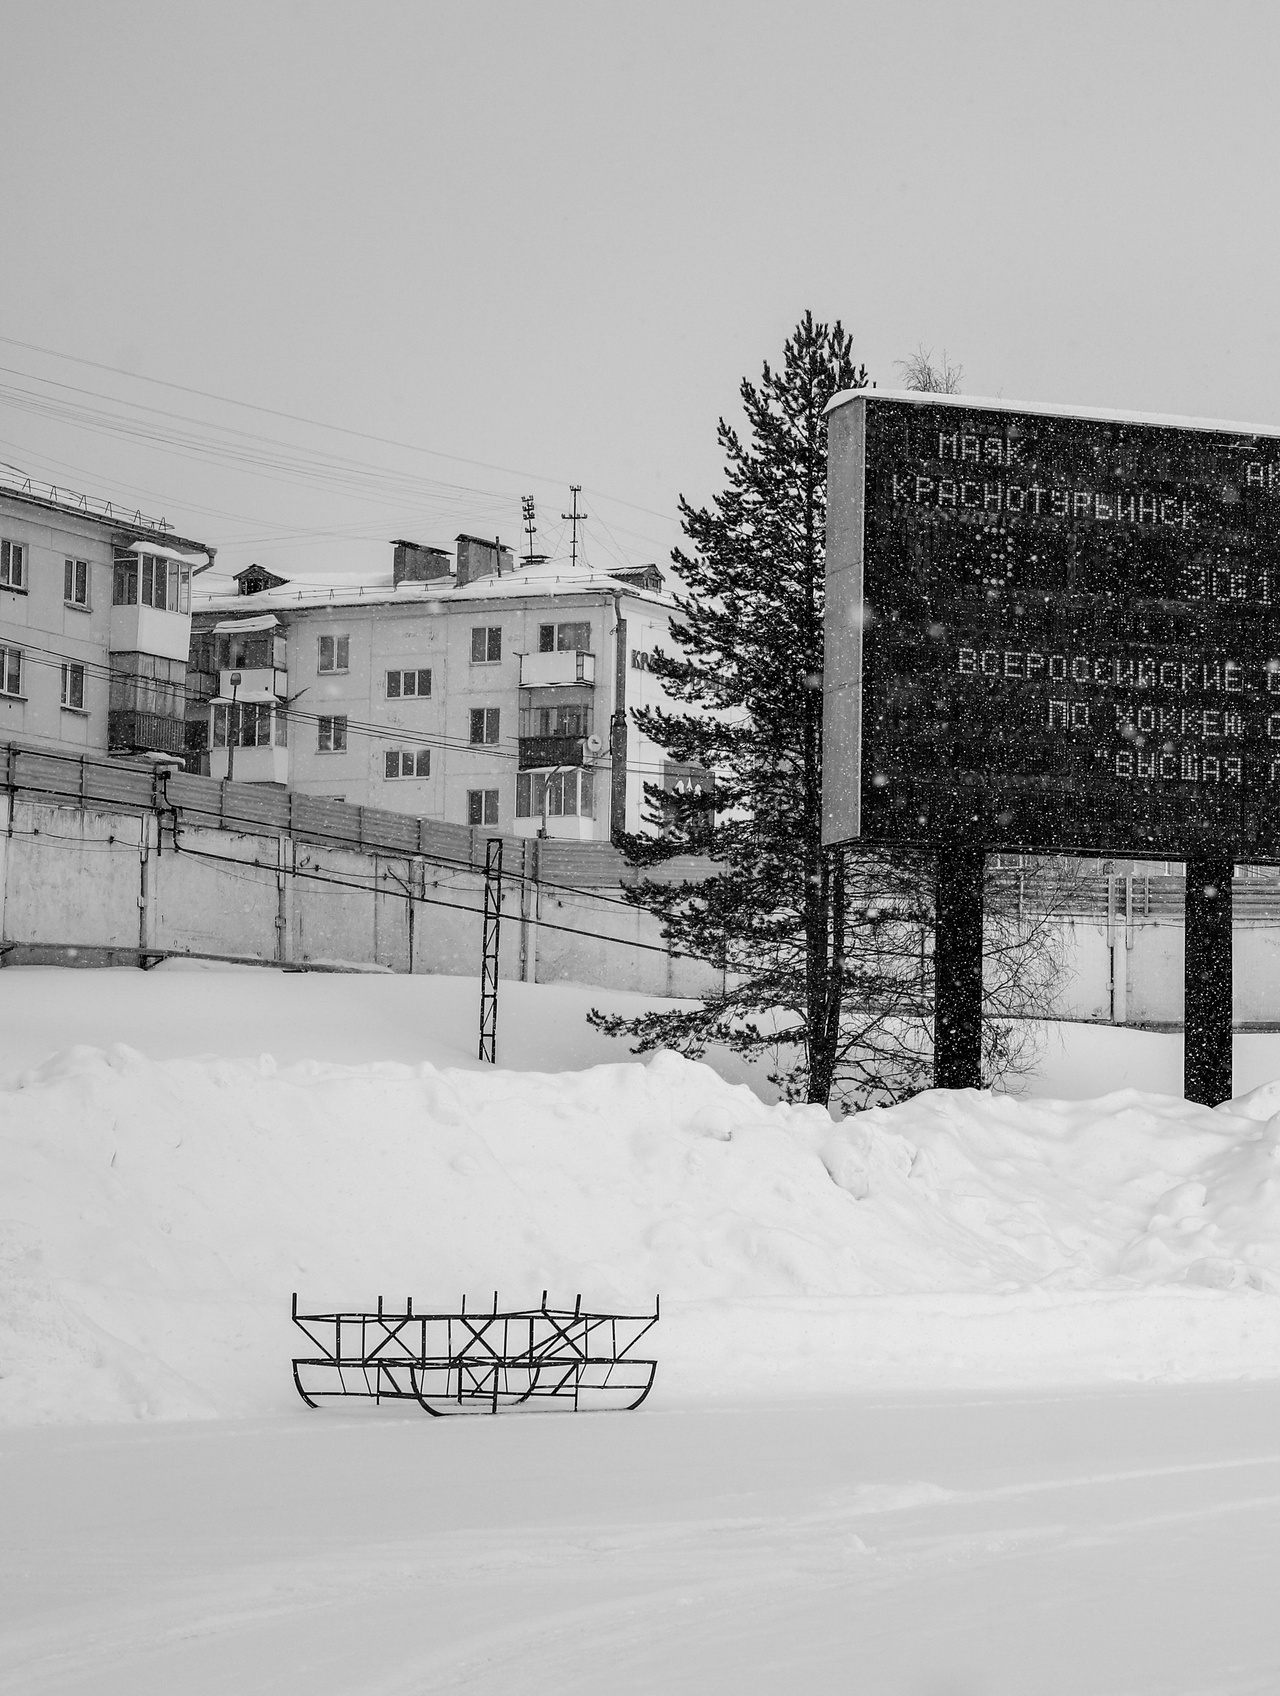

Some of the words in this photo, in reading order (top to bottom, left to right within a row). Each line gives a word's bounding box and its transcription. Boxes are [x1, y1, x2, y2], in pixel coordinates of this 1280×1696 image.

[938, 431, 1027, 467] МАЯК
[892, 474, 1200, 529] КРАСНОТУРЬИНСК
[974, 526, 1014, 586] 3
[957, 647, 1242, 693] ВСЕРОССИЙСКИЕ
[1048, 699, 1089, 729] ПО
[1115, 704, 1242, 737] ХОККЕЮ
